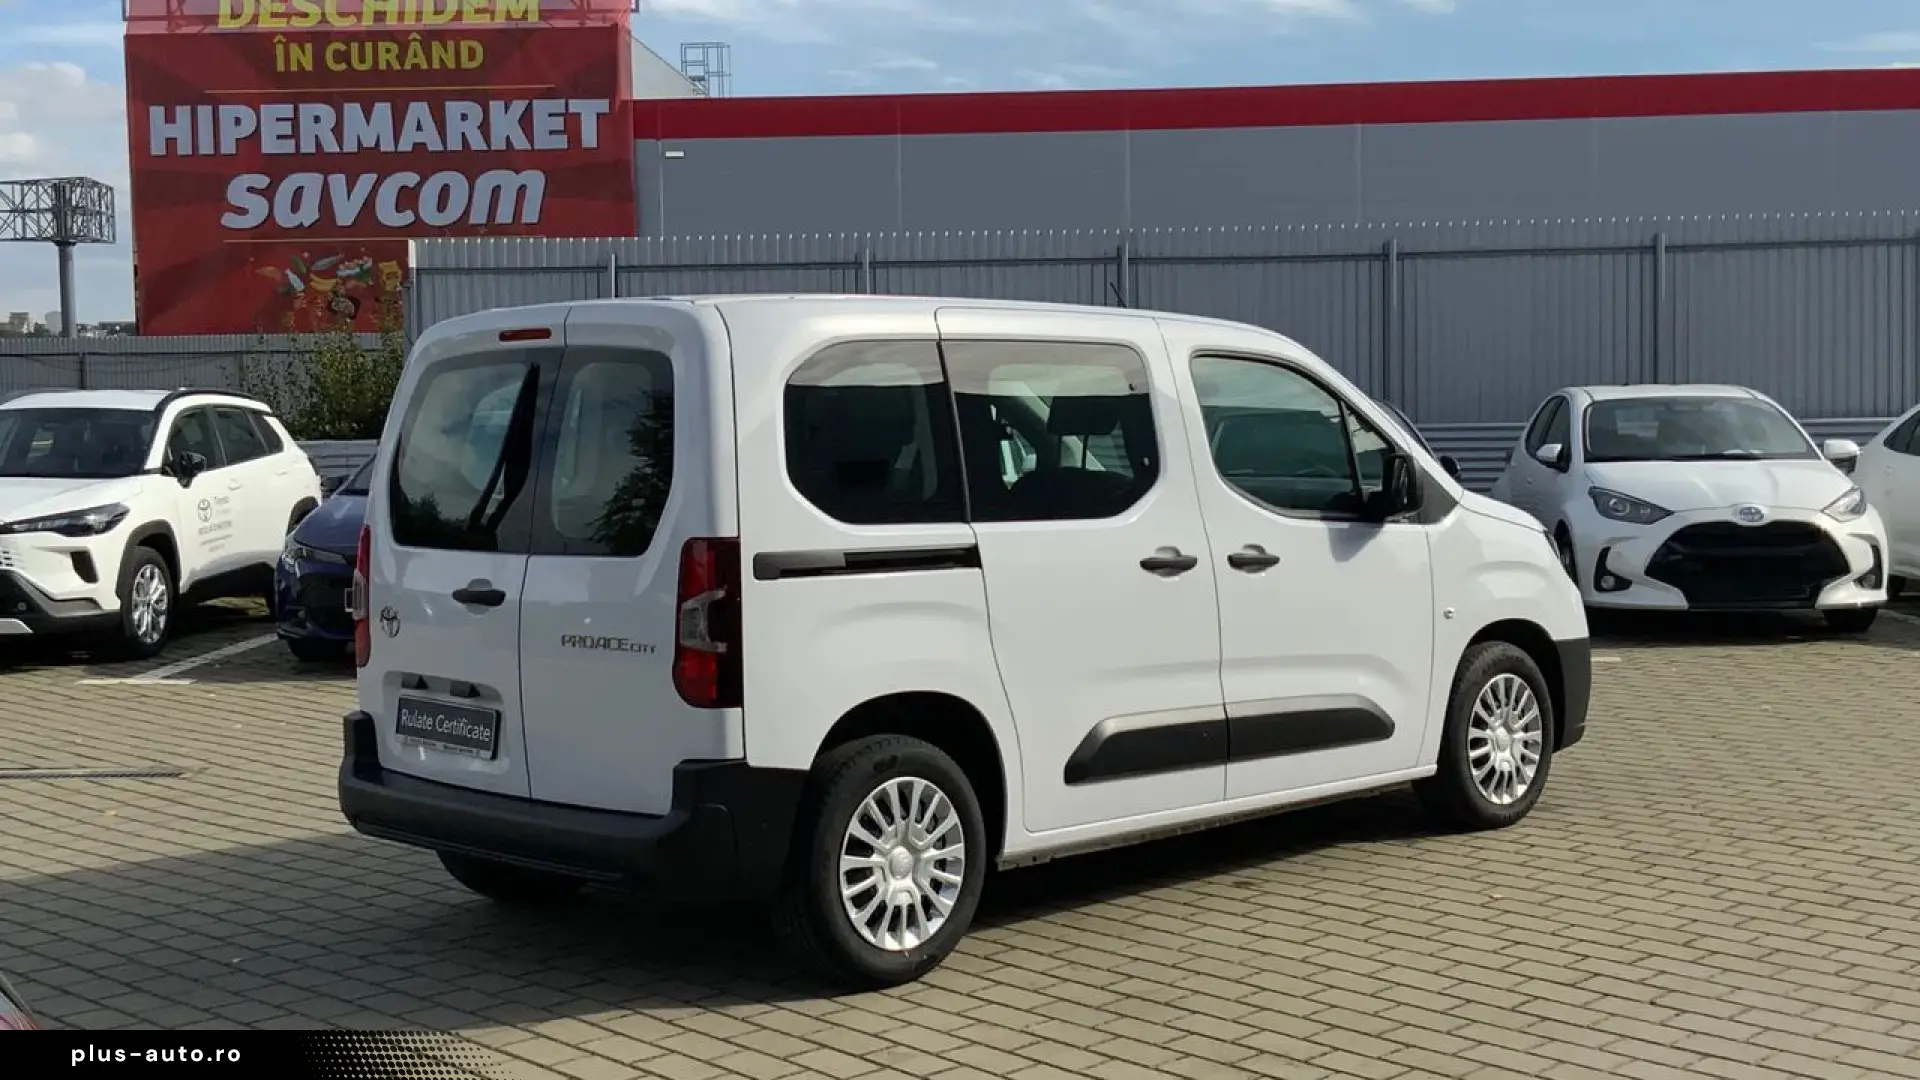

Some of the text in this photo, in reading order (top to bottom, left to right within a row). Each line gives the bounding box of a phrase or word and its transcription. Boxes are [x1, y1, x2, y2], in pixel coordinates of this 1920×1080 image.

[217, 0, 540, 28] DESCHIDEM
[273, 31, 484, 73] ÎN CURÂND
[148, 98, 610, 156] HIPERMARKET
[219, 168, 547, 230] savcom
[560, 633, 630, 652] PROACE
[400, 707, 492, 742] Rulate Certificate
